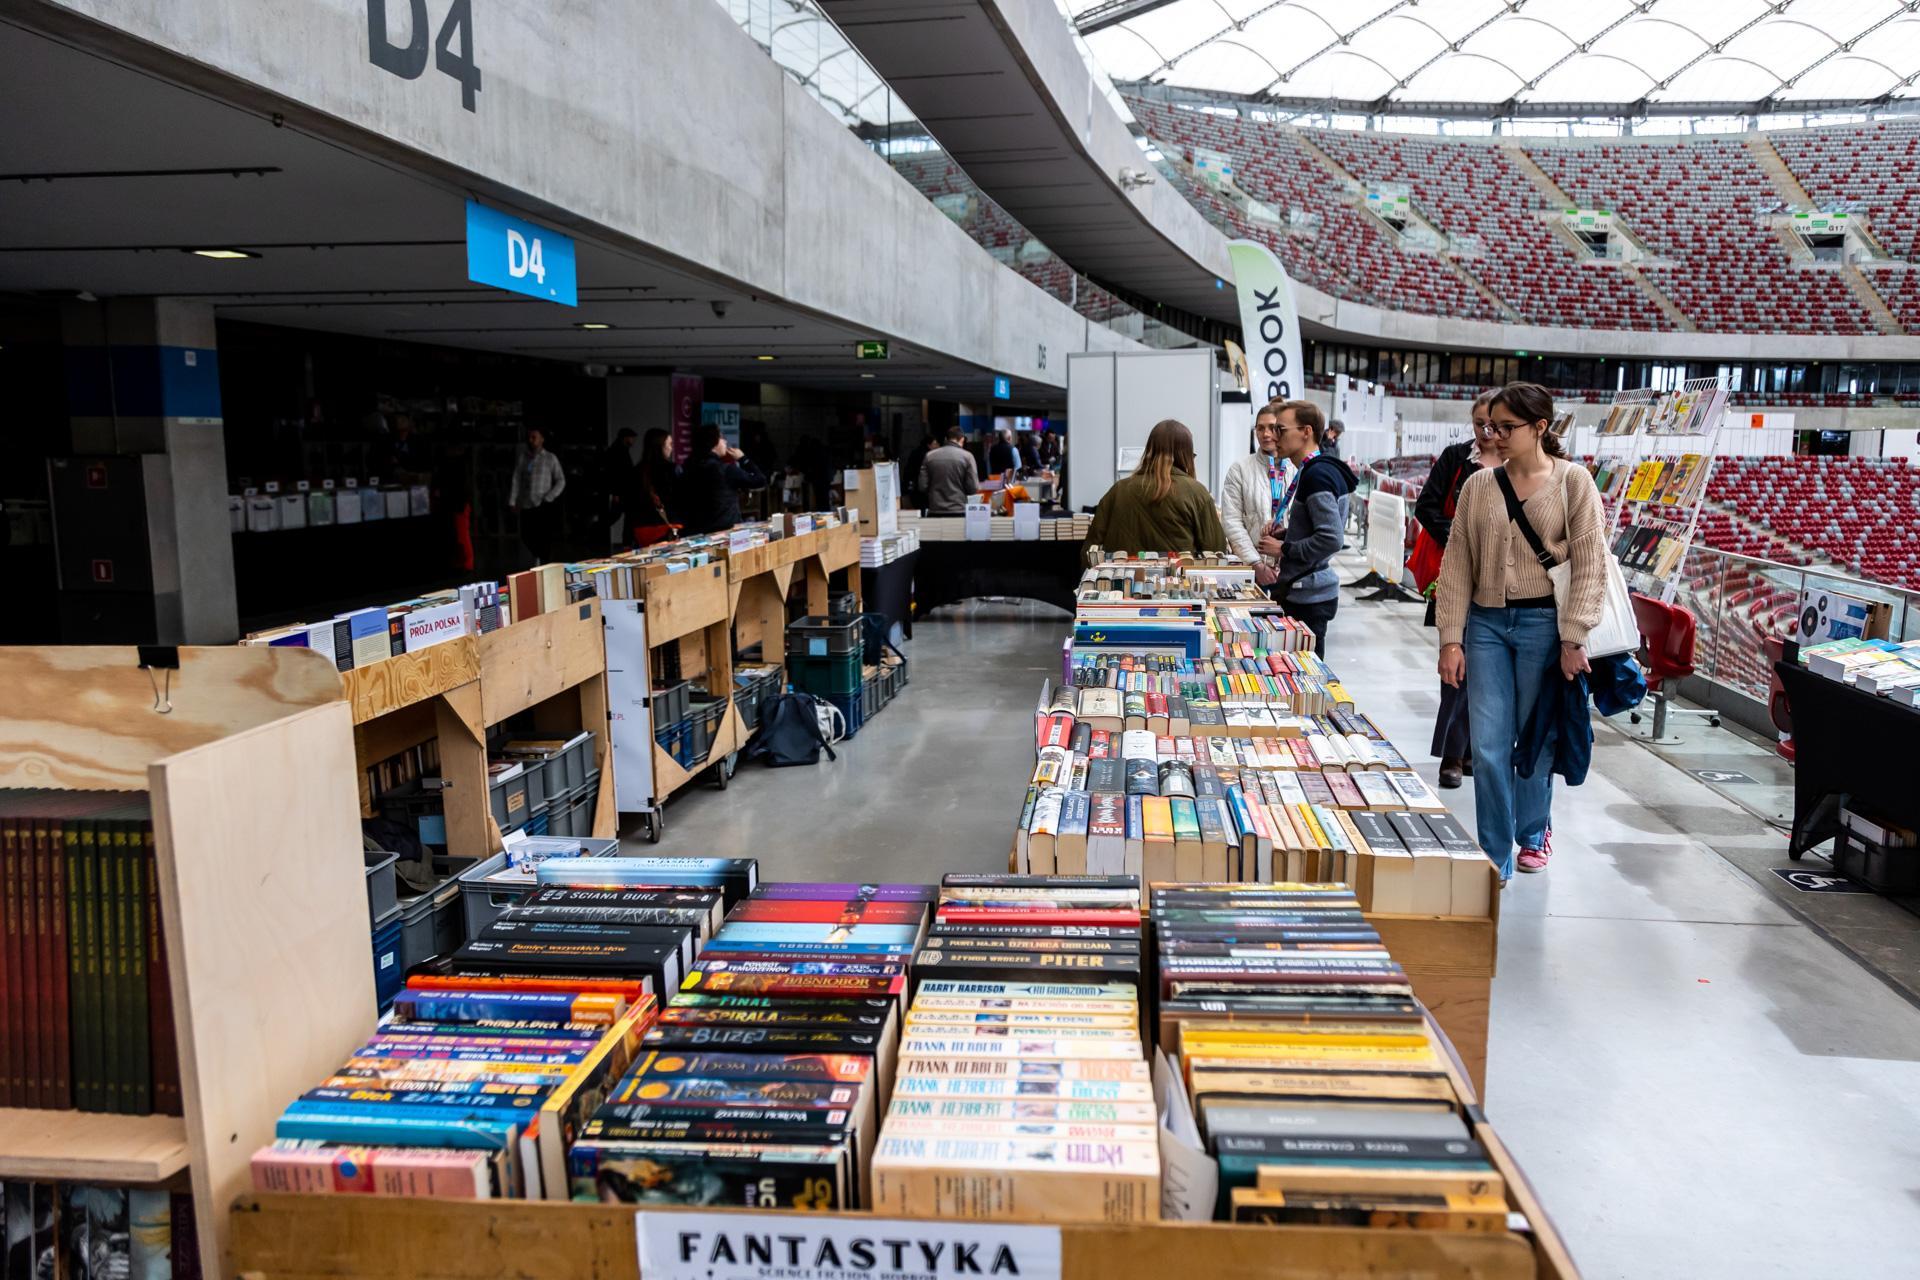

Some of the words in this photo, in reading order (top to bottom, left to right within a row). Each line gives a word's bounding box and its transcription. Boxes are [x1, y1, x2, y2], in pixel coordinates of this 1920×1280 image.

[367, 0, 482, 113] D4
[507, 227, 546, 284] D4
[1253, 286, 1290, 401] BOOK
[410, 624, 433, 638] PROZA
[435, 616, 461, 630] POLSKA
[622, 892, 659, 901] BURZ
[1040, 954, 1105, 967] PITER
[923, 983, 956, 993] HARRY
[957, 984, 1006, 994] HARRISON
[704, 1008, 779, 1022] SPIRALA
[562, 1021, 598, 1031] UBIK
[906, 1041, 946, 1052] FRANK
[951, 1042, 1003, 1052] HERBERT
[908, 1060, 952, 1073] FRANK
[954, 1062, 1008, 1074] HERBERT
[899, 1079, 938, 1092] FRANK
[947, 1080, 1004, 1094] HERBERT
[349, 1090, 394, 1101] Dick
[892, 1101, 933, 1115] FRANK
[940, 1102, 1004, 1116] HERBERT
[881, 1138, 925, 1158] FRANK
[935, 1139, 1000, 1161] HERBERT
[678, 1232, 1021, 1280] FANTASTYKA
[758, 1267, 812, 1279] SCIENCE
